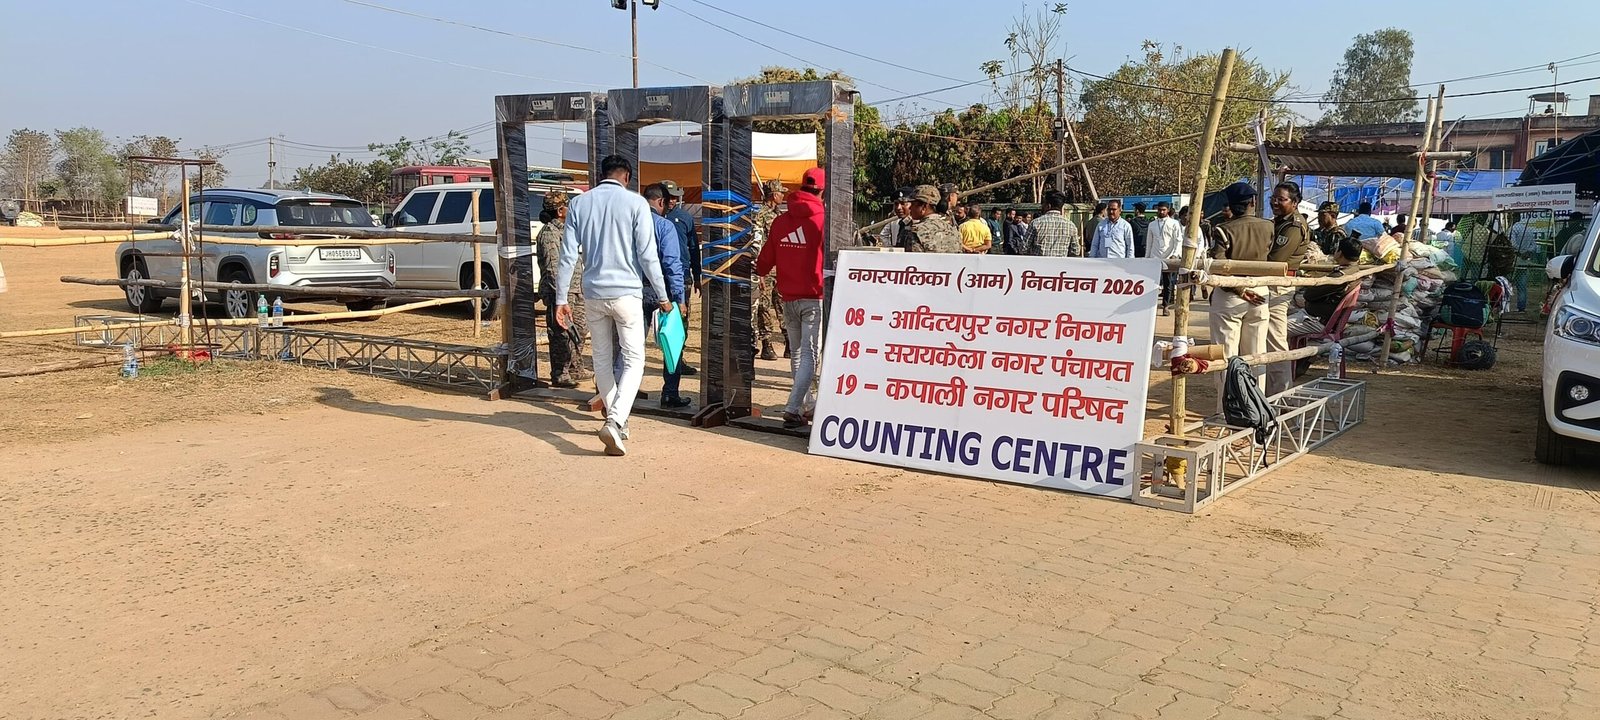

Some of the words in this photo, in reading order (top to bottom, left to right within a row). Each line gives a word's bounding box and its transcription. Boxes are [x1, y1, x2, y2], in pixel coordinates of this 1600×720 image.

[848, 266, 951, 288] नगरपालिका
[956, 267, 1013, 296] (आम)
[1021, 270, 1098, 294] निर्वाचन
[1102, 279, 1145, 296] 2026
[845, 308, 865, 326] 08
[889, 305, 992, 342] आदित्यपुर
[996, 316, 1049, 339] नगर
[1055, 314, 1126, 344] निगम
[841, 341, 860, 360] 18
[884, 342, 986, 369] सरायकेला
[991, 352, 1047, 375] नगर
[1051, 349, 1134, 383] पंचायत
[836, 375, 857, 395] 19
[886, 377, 967, 407] कपाली
[973, 385, 1037, 414] नगर
[1042, 387, 1129, 424] परिषद
[820, 415, 982, 466] COUNTING
[991, 435, 1128, 486] CENTRE
